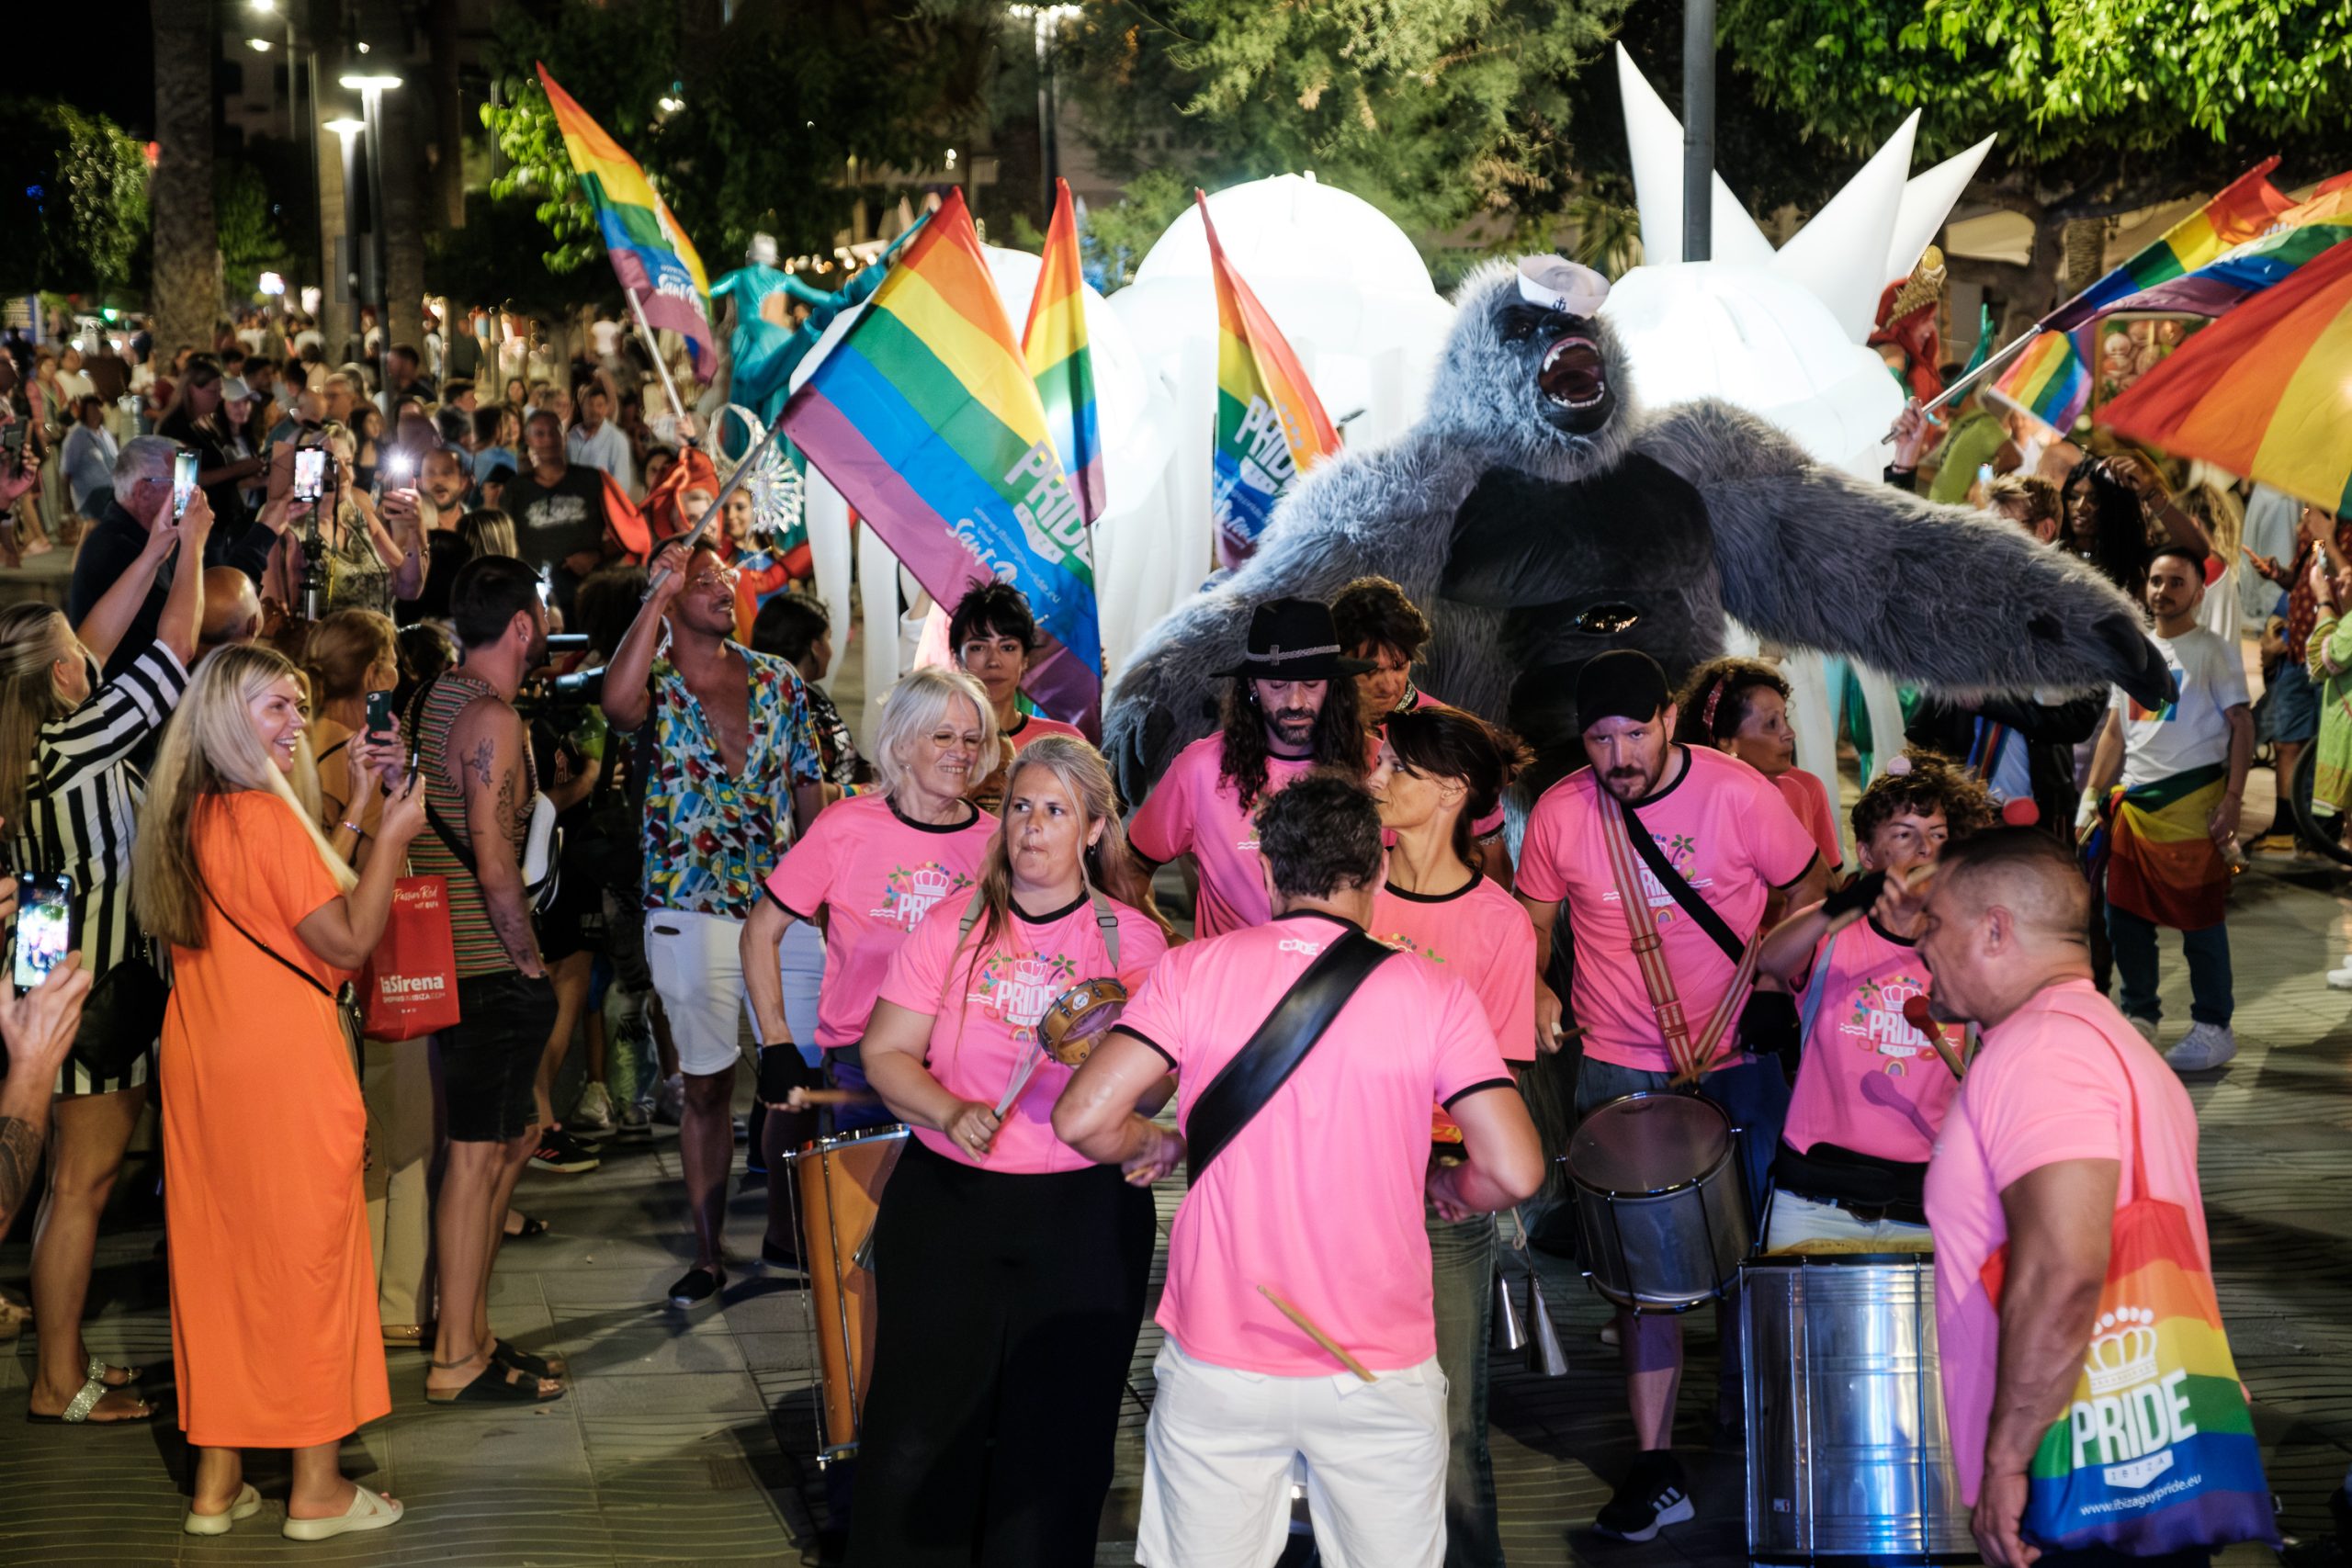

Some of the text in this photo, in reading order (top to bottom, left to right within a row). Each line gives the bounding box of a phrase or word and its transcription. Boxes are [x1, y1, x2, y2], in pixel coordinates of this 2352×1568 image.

[1234, 394, 1298, 480] PRID
[1004, 440, 1095, 570] PRID
[945, 518, 997, 567] Sant
[379, 975, 445, 993] laSirena
[2072, 1368, 2198, 1470] PRIDE
[2111, 1456, 2165, 1481] IBIZA
[2080, 1473, 2201, 1516] www.ibizagaypride.eu
